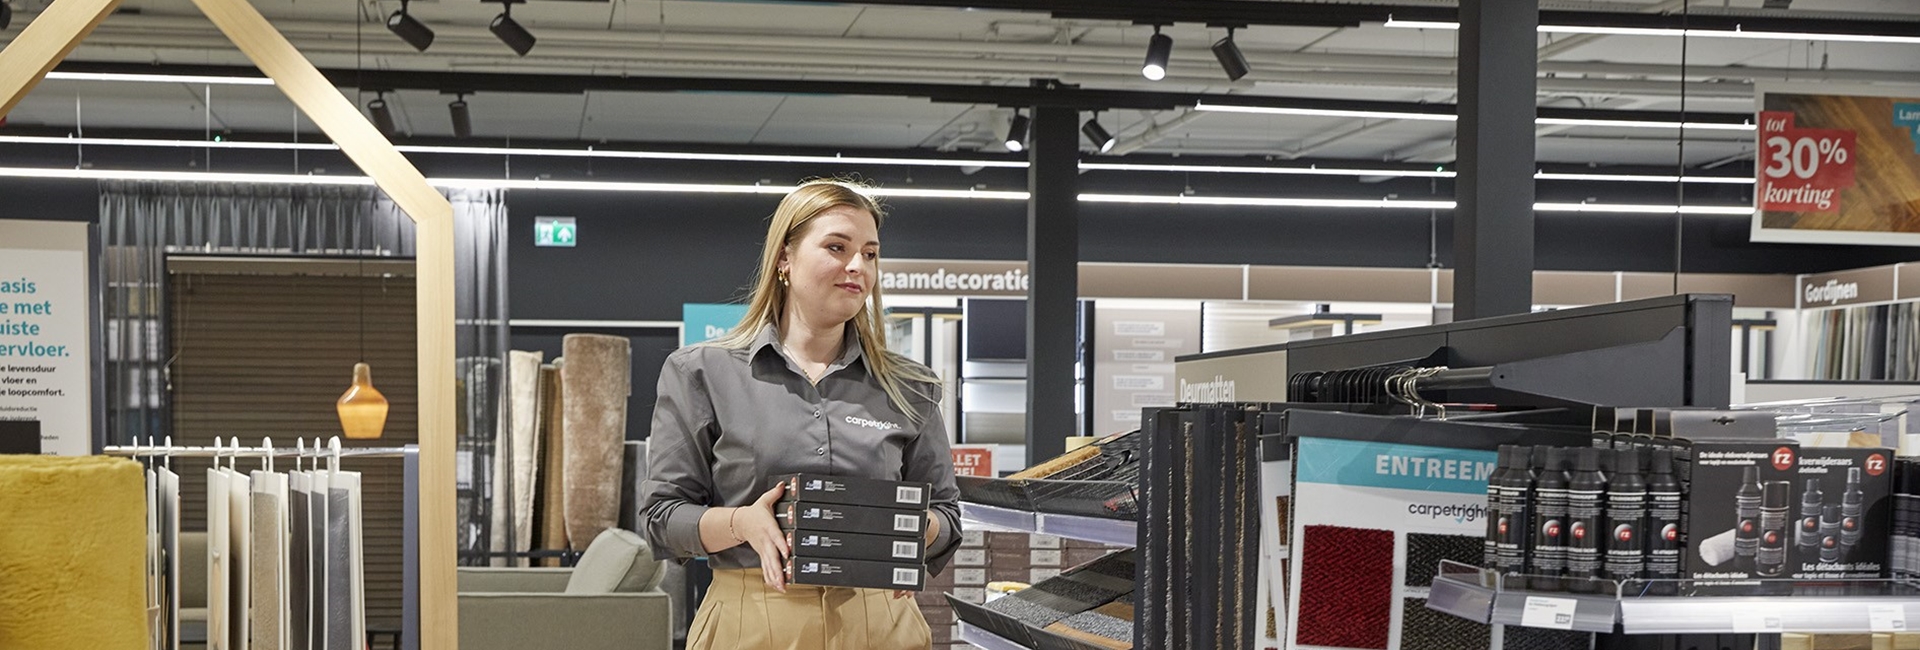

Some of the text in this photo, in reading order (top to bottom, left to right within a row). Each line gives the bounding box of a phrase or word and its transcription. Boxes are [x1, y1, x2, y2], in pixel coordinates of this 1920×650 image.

[1765, 117, 1786, 132] tot
[1765, 136, 1847, 179] 30%
[1764, 182, 1834, 210] korting
[1805, 279, 1858, 304] Gordijnen
[14, 301, 52, 315] met
[8, 364, 56, 373] levensduur
[2, 376, 24, 384] vloer
[8, 388, 65, 397] loopcomfort.
[1180, 375, 1235, 403] Deurmatten
[1774, 453, 1791, 464] rz
[1867, 460, 1883, 470] rz
